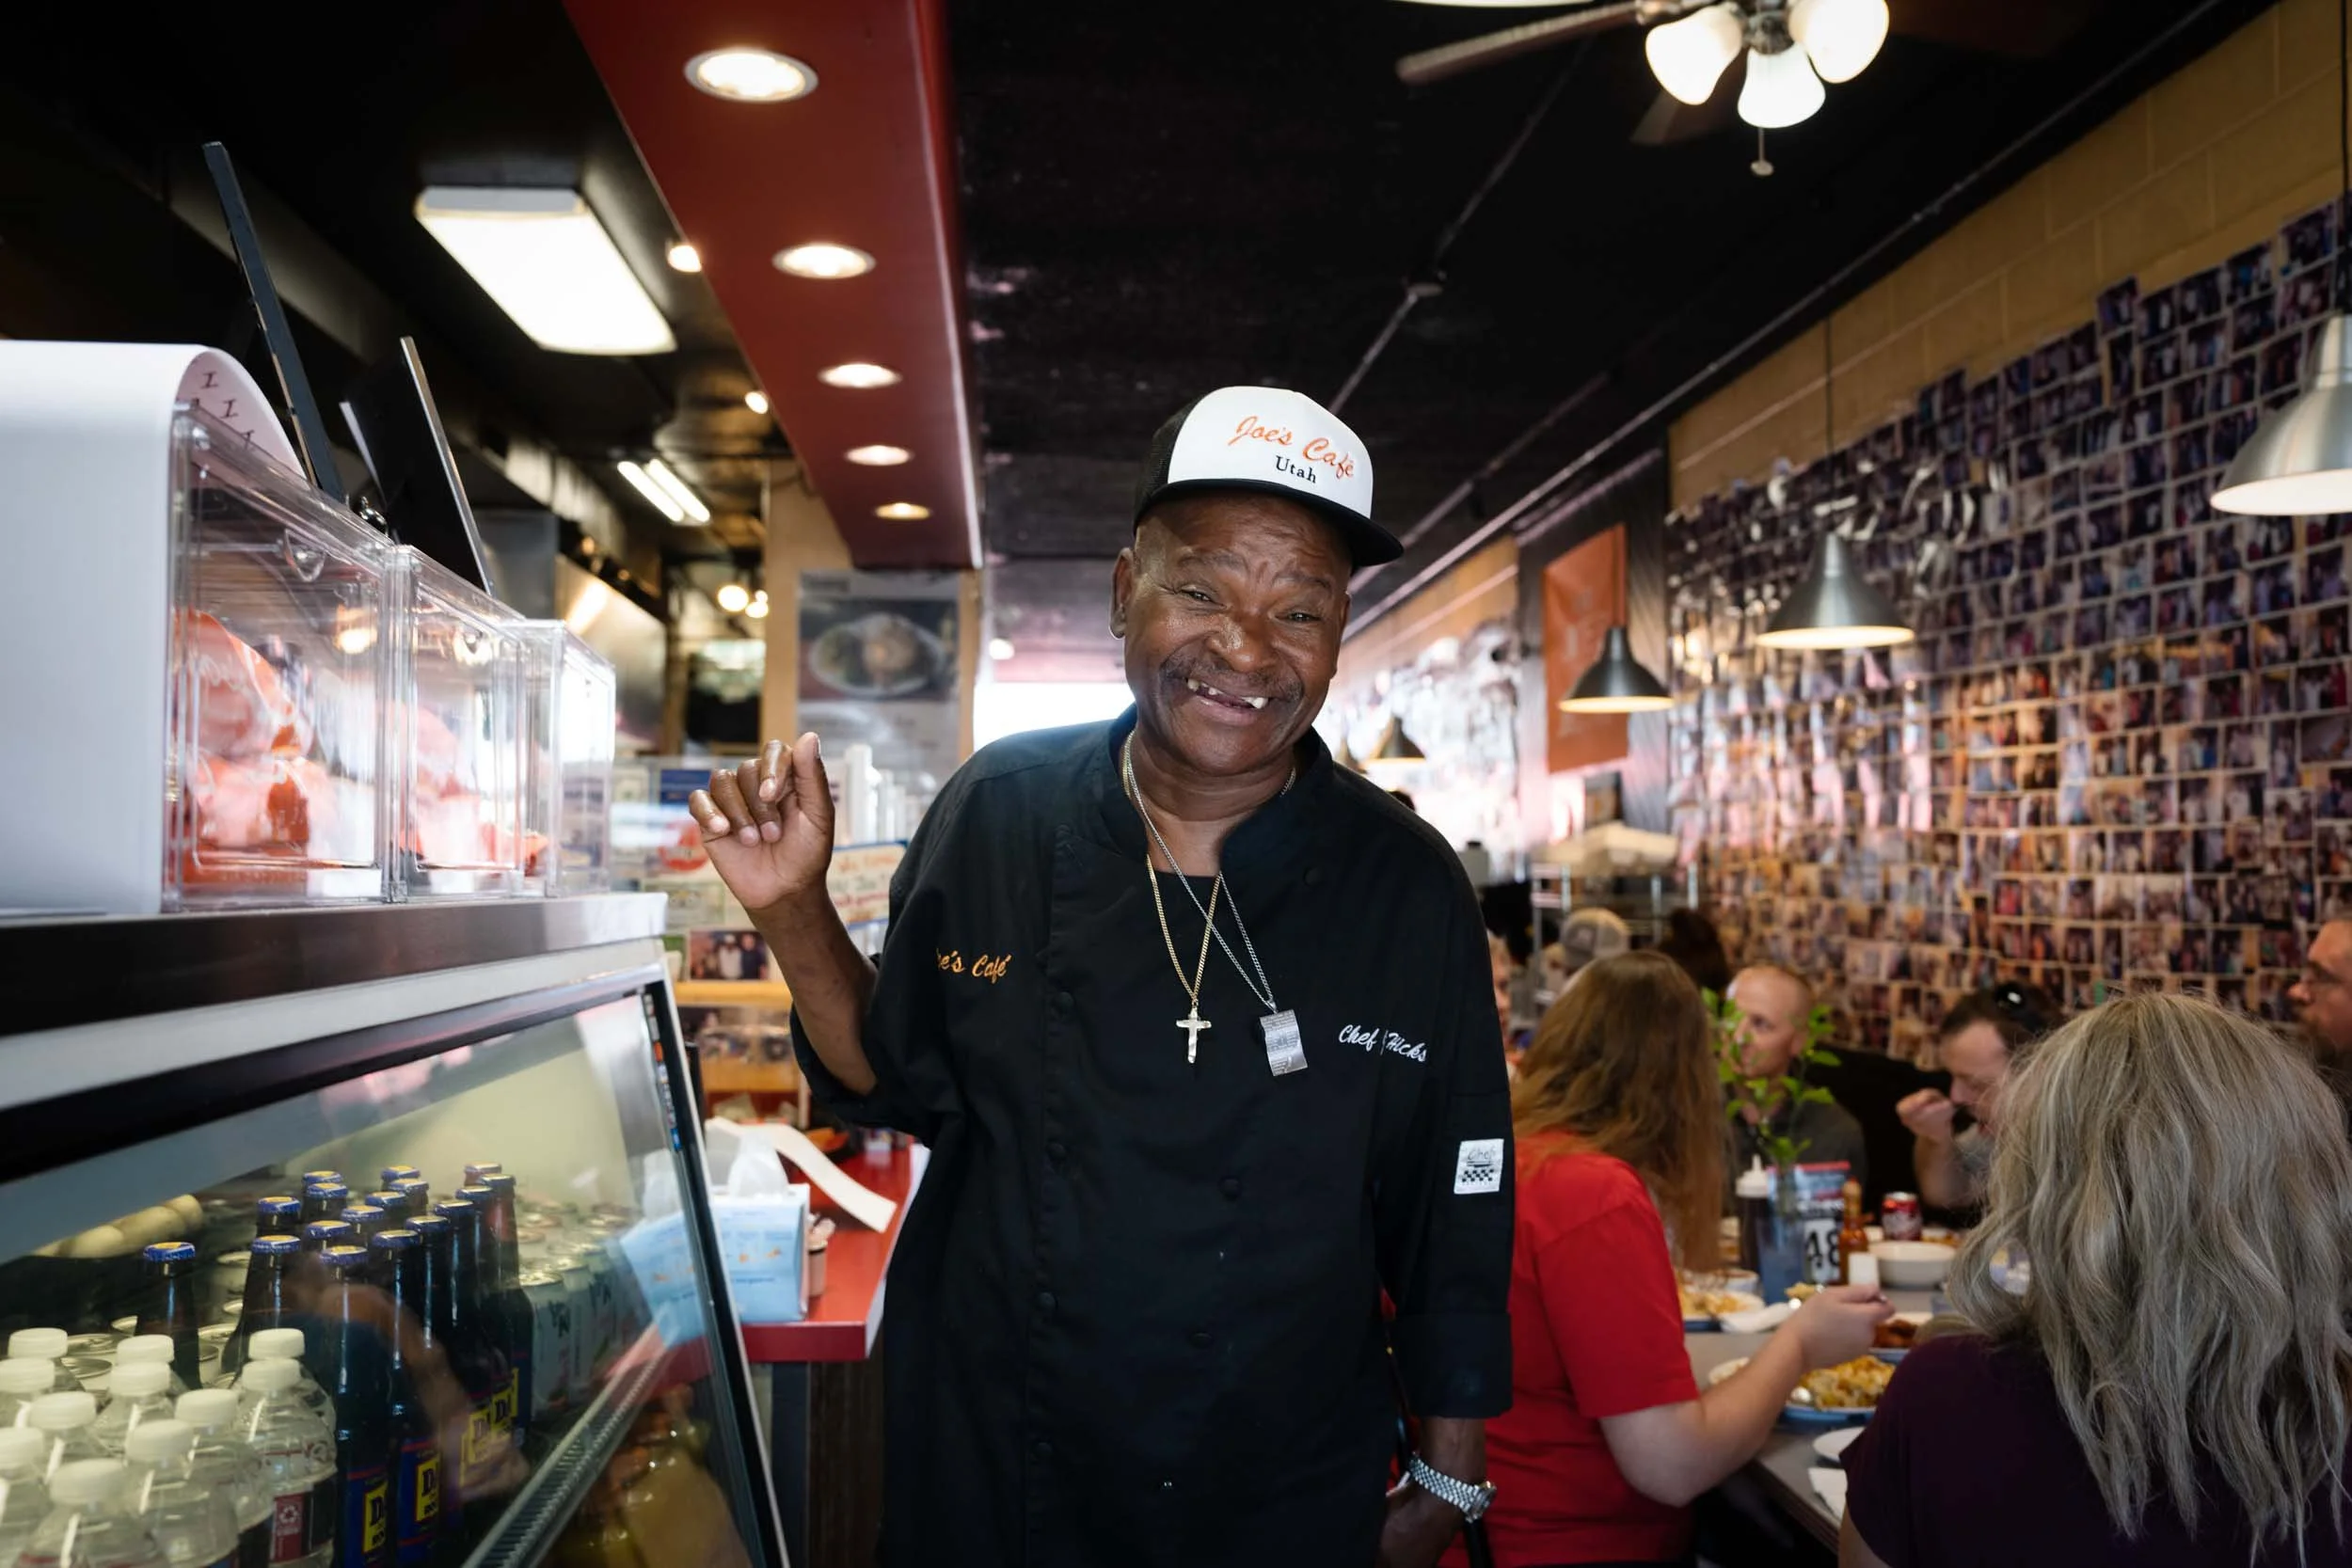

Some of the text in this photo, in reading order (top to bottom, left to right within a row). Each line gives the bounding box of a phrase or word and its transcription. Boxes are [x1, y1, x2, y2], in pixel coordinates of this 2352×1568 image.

[1228, 415, 1293, 446] Joe's
[1275, 455, 1317, 483] Utah
[1339, 1023, 1380, 1053] Chef
